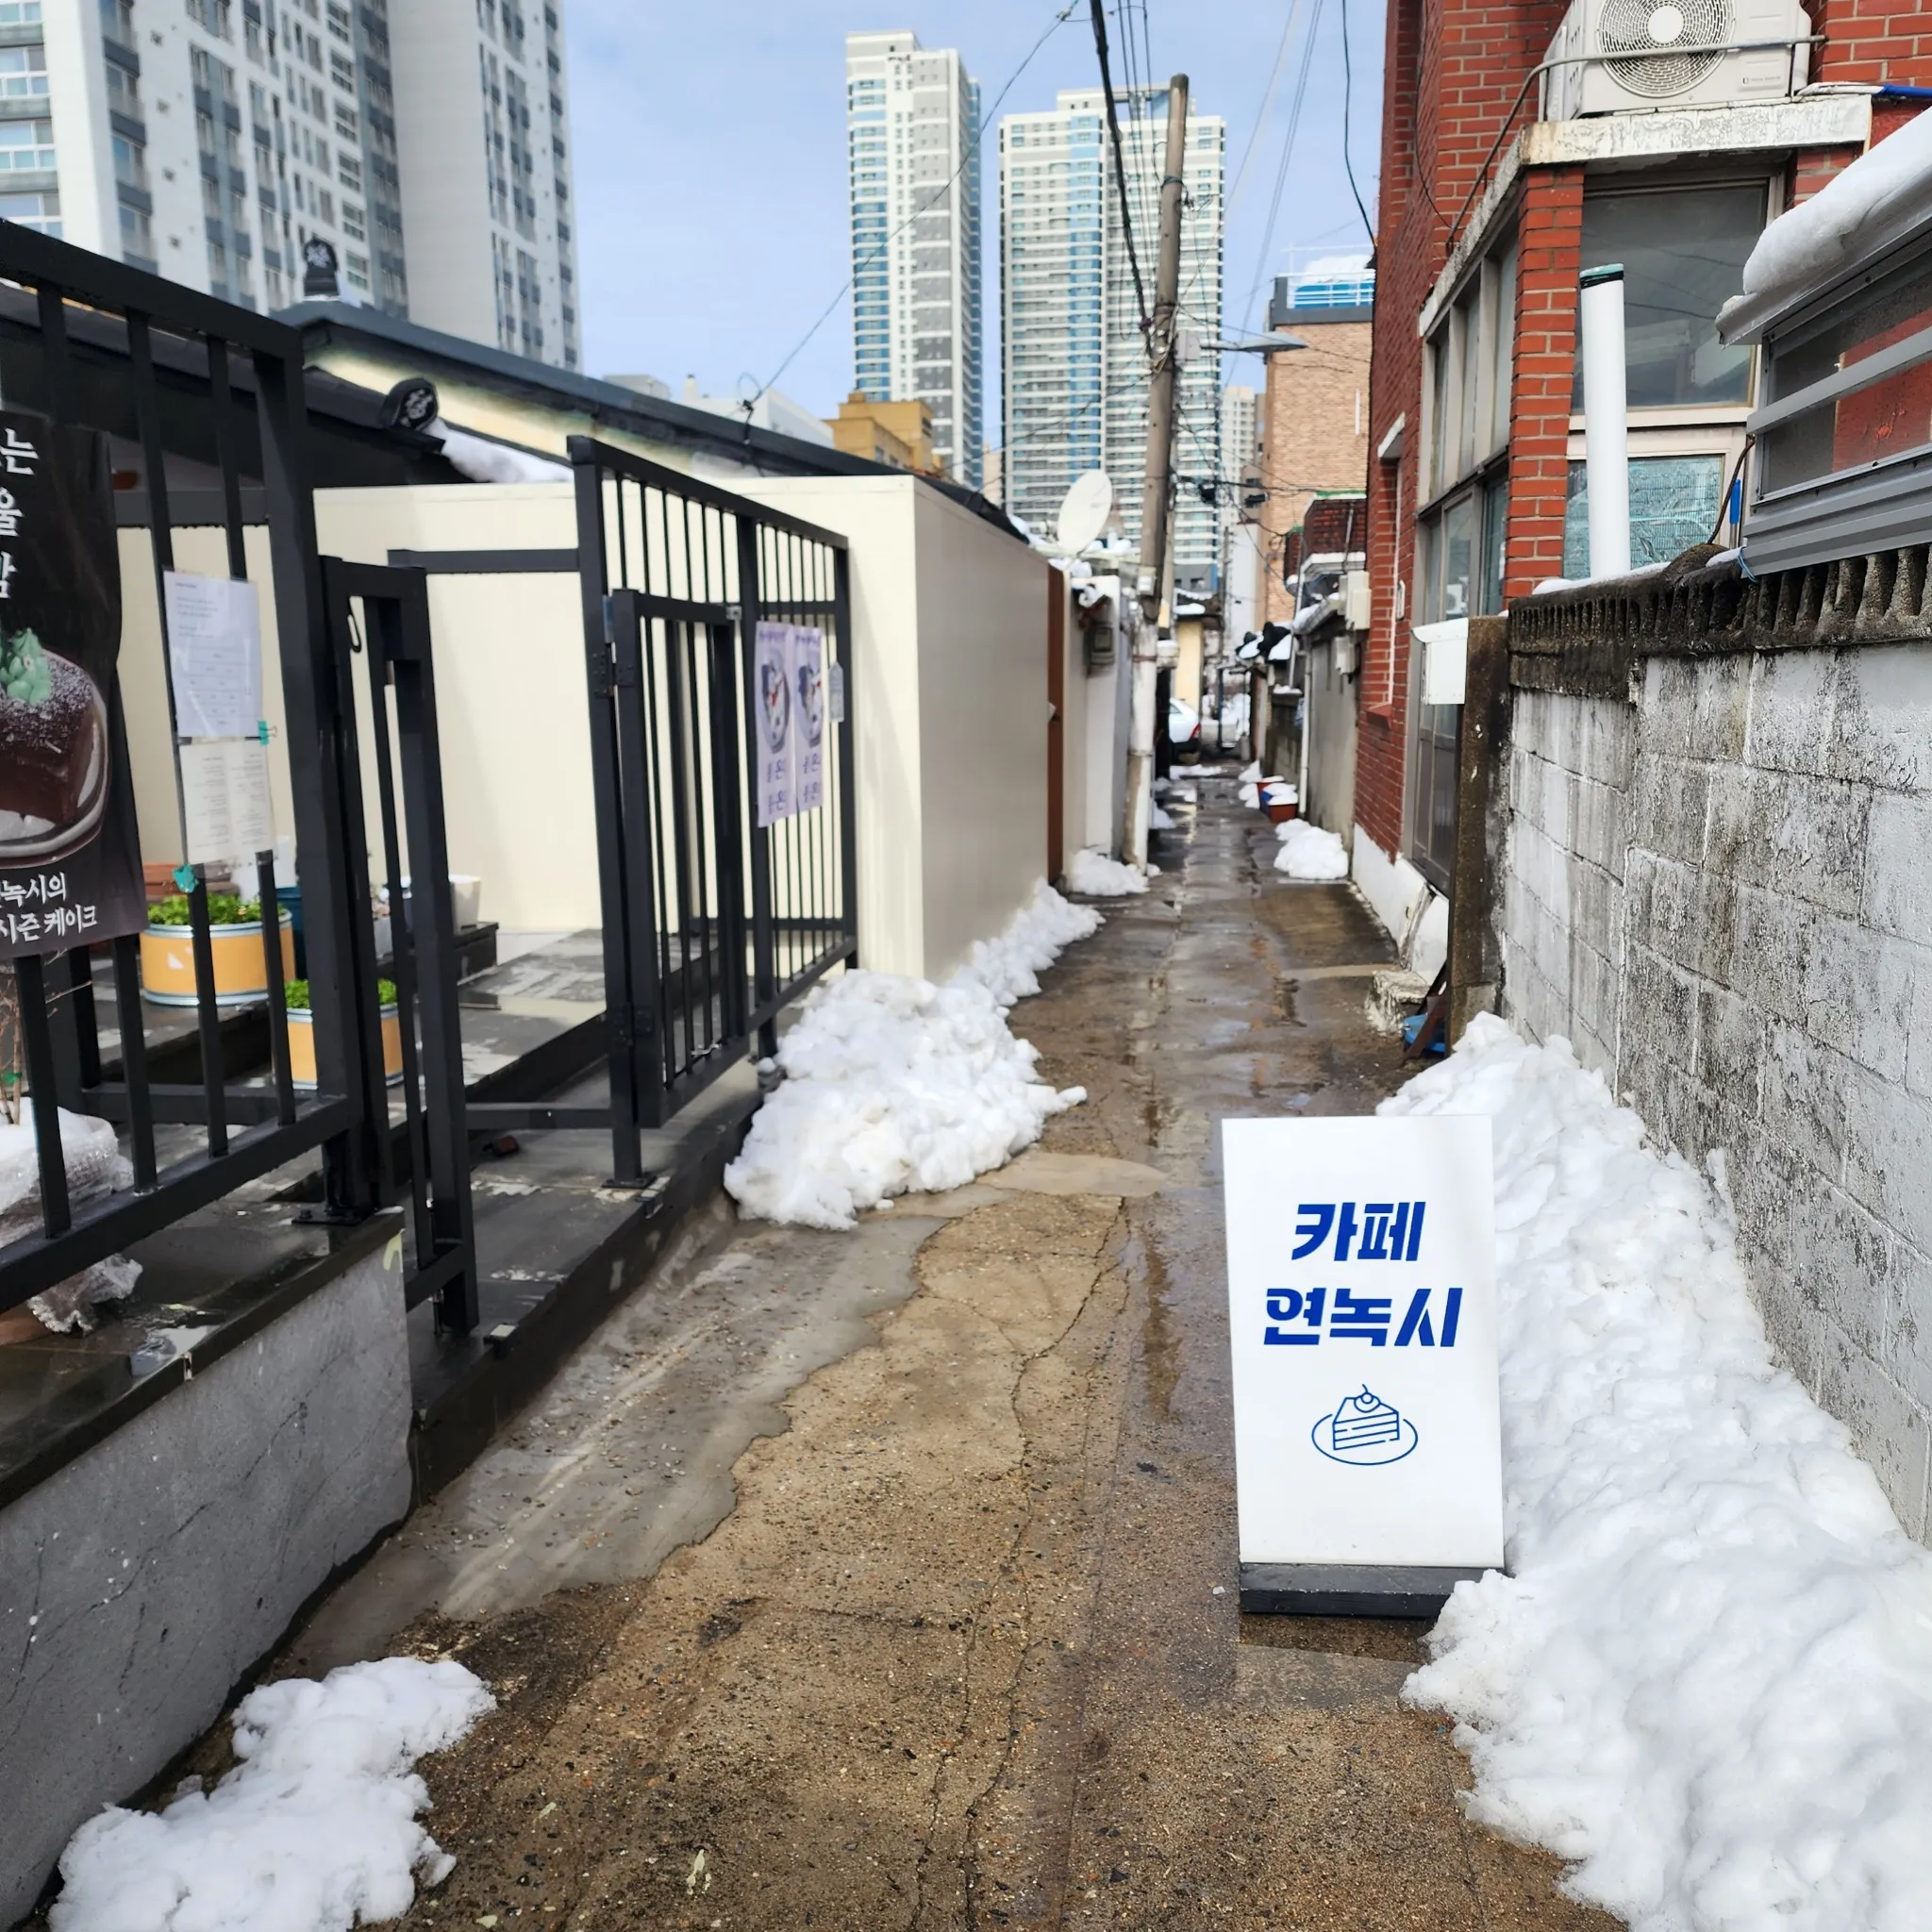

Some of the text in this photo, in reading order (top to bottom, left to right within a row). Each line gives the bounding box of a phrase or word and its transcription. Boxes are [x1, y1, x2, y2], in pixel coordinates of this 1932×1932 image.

[0, 428, 39, 475] 는
[0, 872, 66, 908] 녹시의
[0, 903, 97, 944] 시즌 케이크
[1291, 1201, 1426, 1262] 카페
[1263, 1287, 1463, 1348] 연녹시
